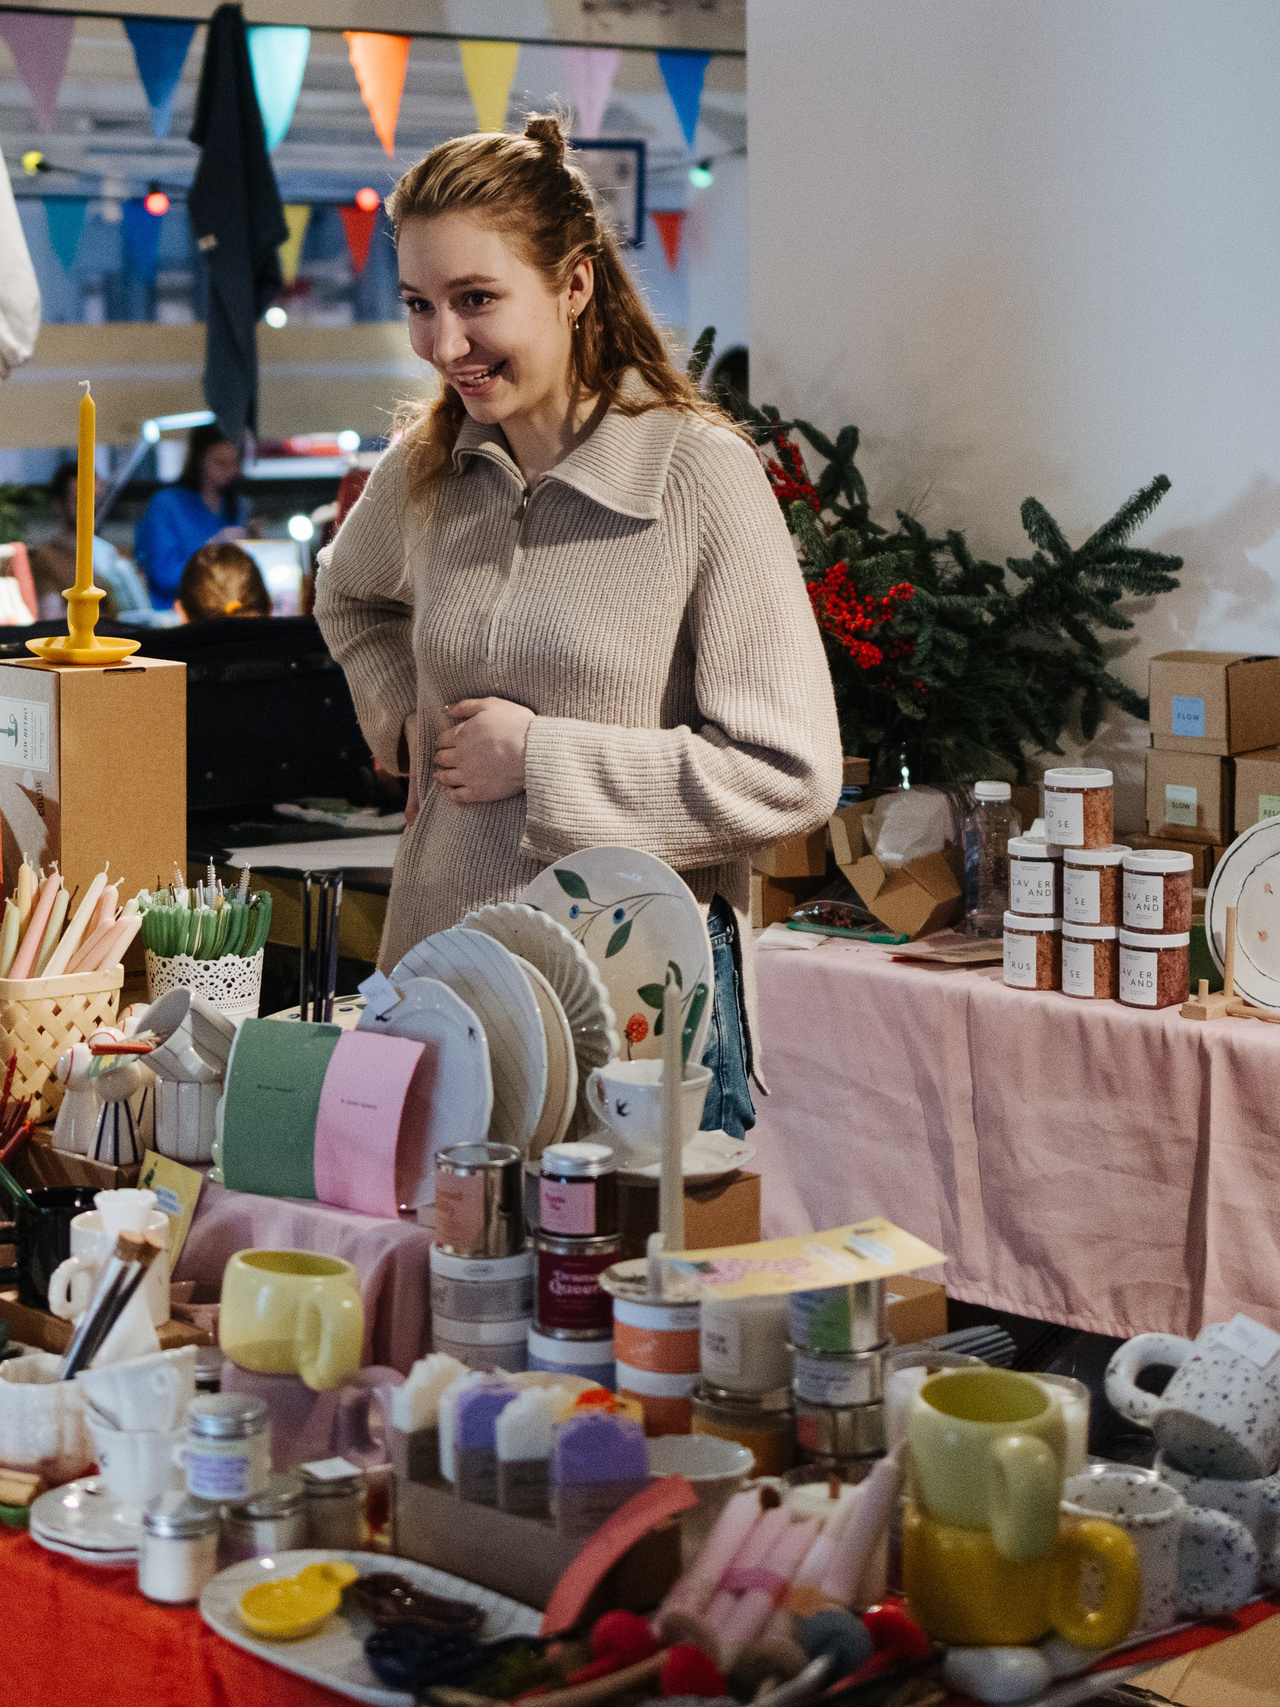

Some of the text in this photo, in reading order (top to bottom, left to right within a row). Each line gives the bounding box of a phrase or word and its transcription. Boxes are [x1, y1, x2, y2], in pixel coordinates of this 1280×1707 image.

[1177, 712, 1200, 721] FLOW
[35, 780, 46, 817] COLOR
[1171, 801, 1191, 810] SLOW
[1028, 889, 1052, 897] AND
[1136, 903, 1159, 912] AND
[1130, 979, 1153, 988] AND
